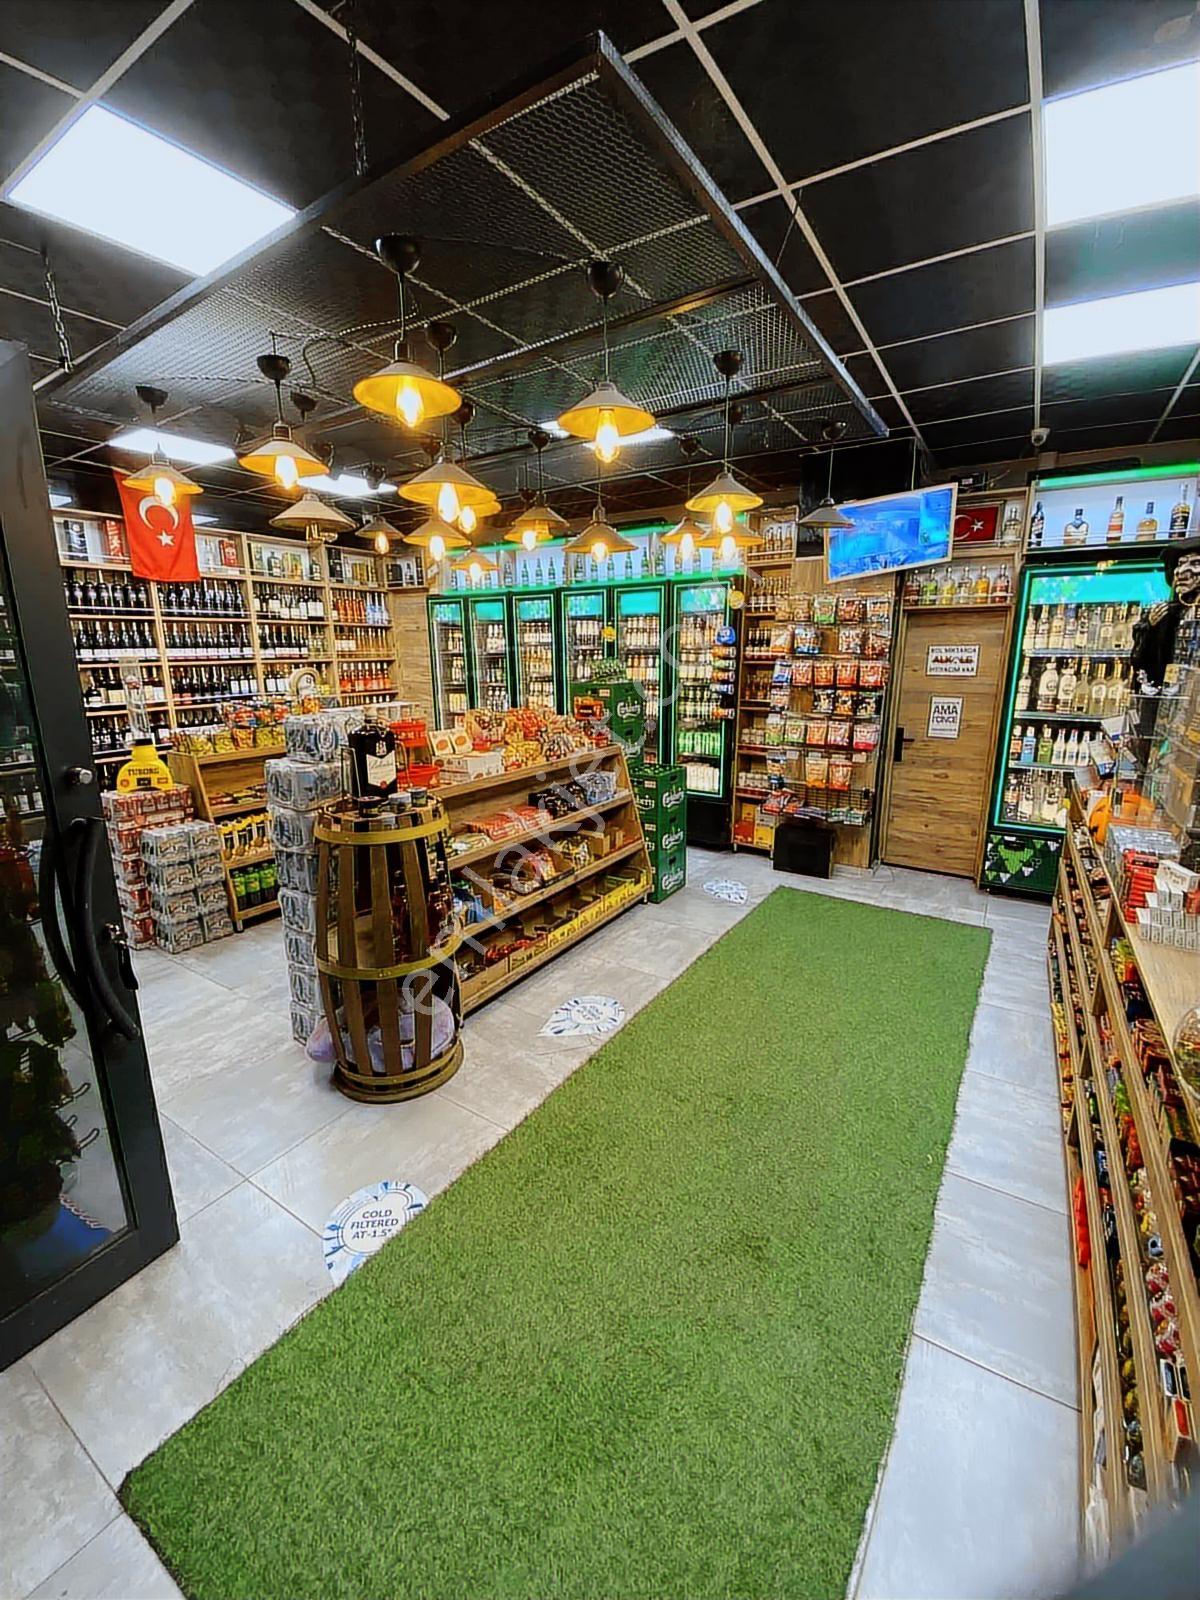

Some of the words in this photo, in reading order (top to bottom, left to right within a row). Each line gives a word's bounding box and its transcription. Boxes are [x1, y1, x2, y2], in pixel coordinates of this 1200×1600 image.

[128, 767, 160, 776] TUBORG
[362, 1209, 392, 1219] COLD
[351, 1218, 399, 1229] FILTERED
